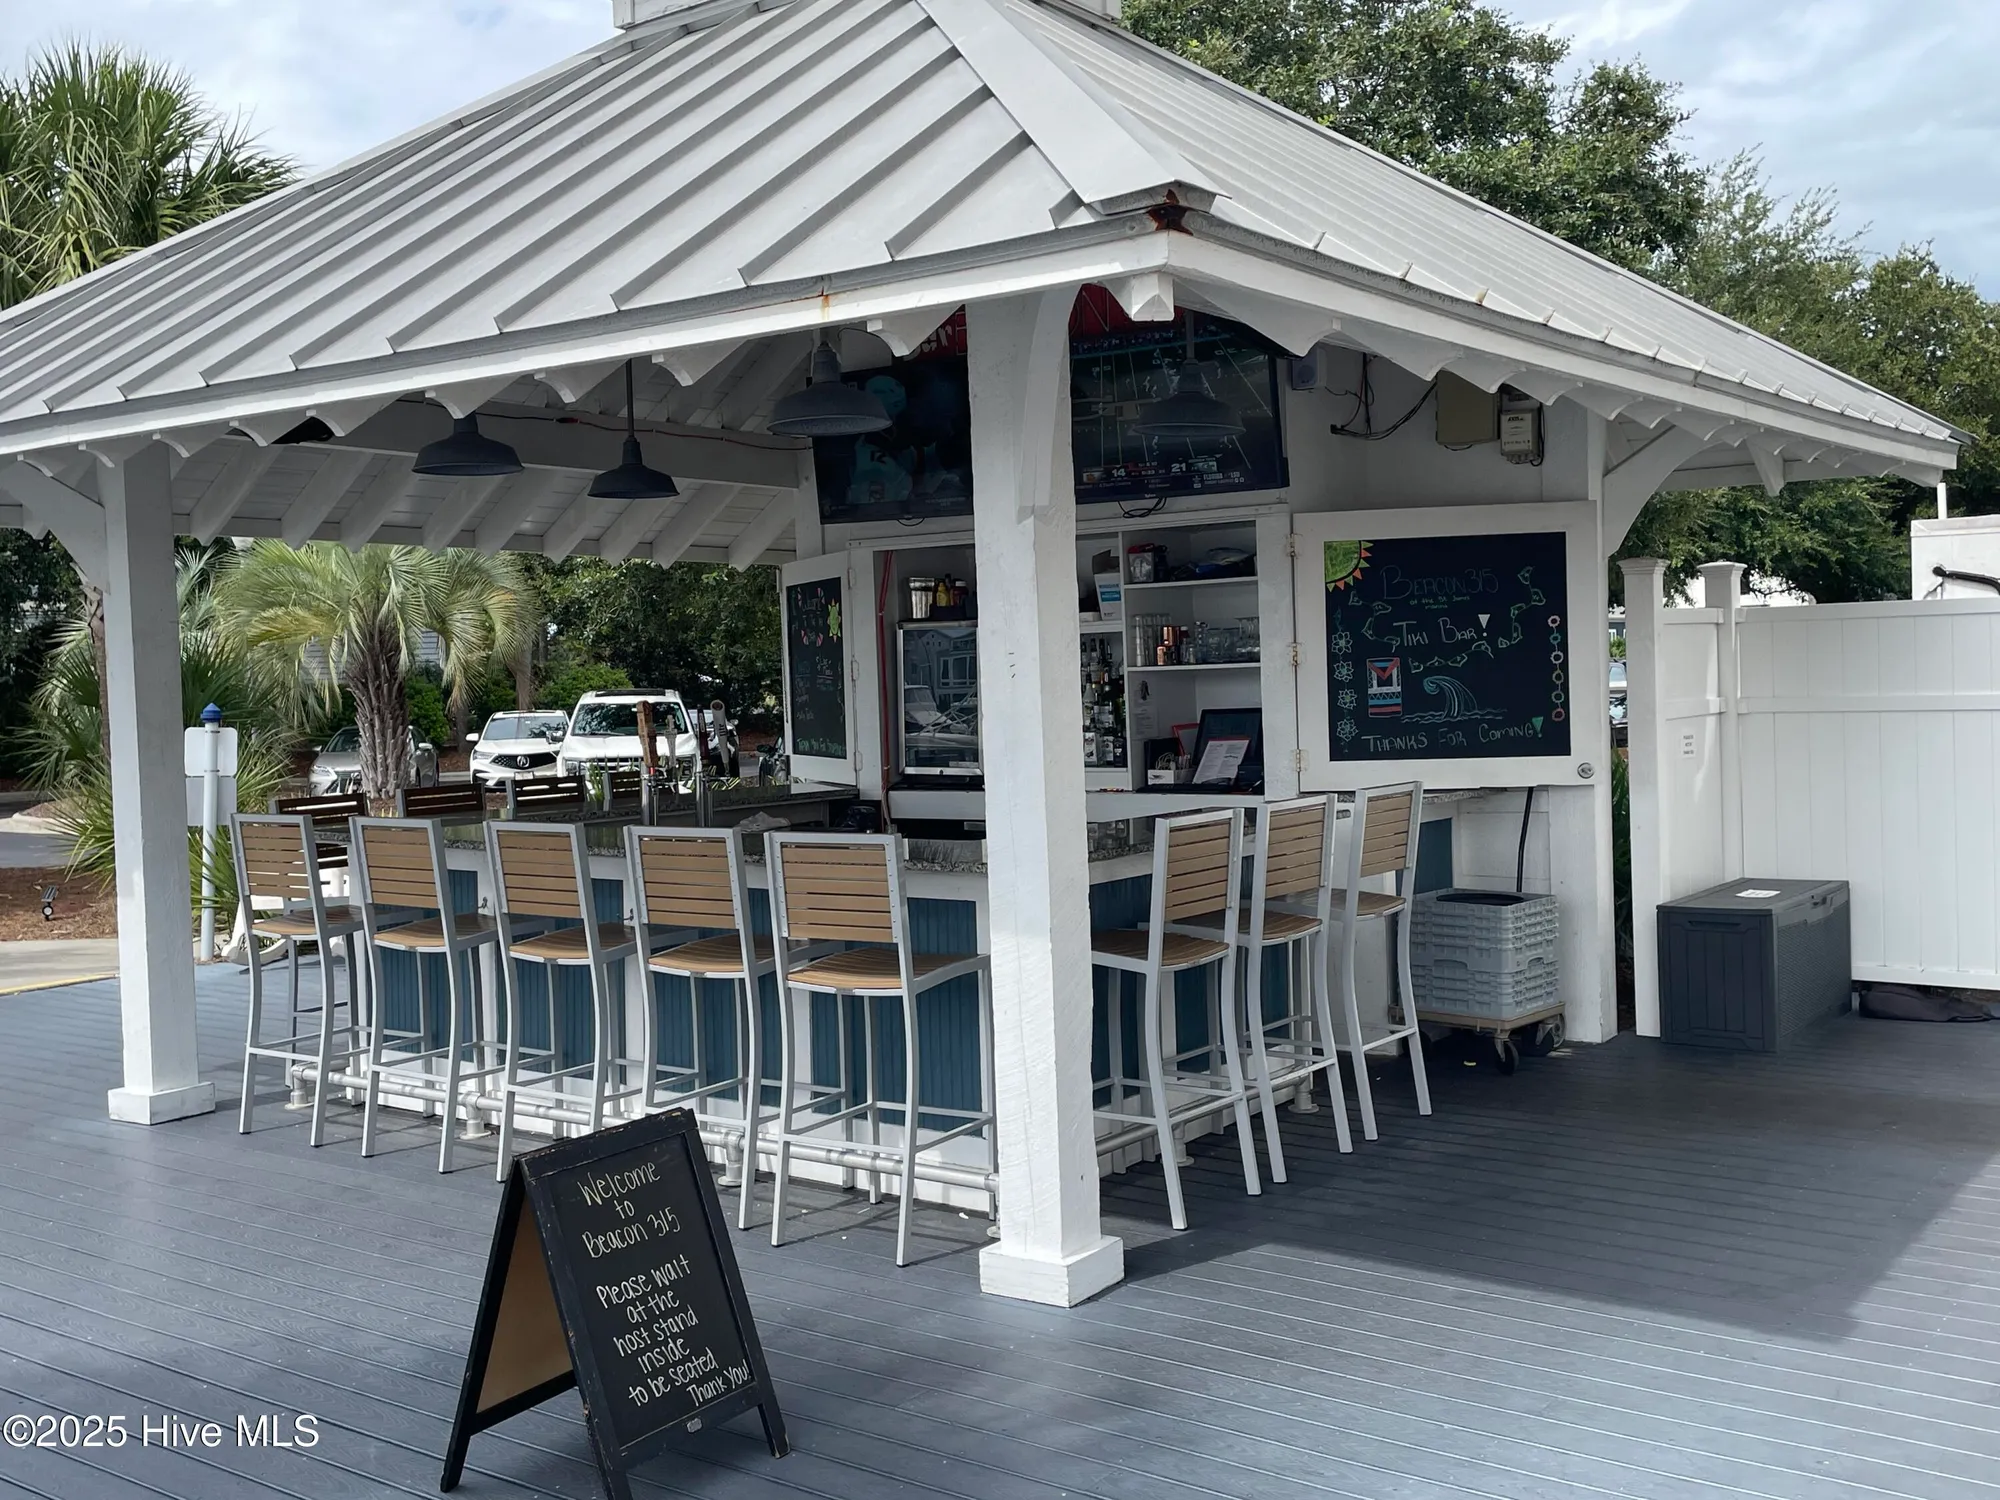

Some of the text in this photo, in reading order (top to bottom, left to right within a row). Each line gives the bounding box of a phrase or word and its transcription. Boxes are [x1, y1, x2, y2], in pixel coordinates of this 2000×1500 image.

[1111, 468, 1126, 477] 14
[577, 1161, 661, 1207] Welcome
[582, 1206, 681, 1260] Beacon 315
[615, 1199, 635, 1220] to
[596, 1254, 692, 1310] Please wait
[626, 1288, 681, 1325] at the
[613, 1304, 700, 1358] host stand
[629, 1347, 719, 1408] to be seated
[639, 1337, 690, 1375] inside
[687, 1358, 753, 1409] Thank You!
